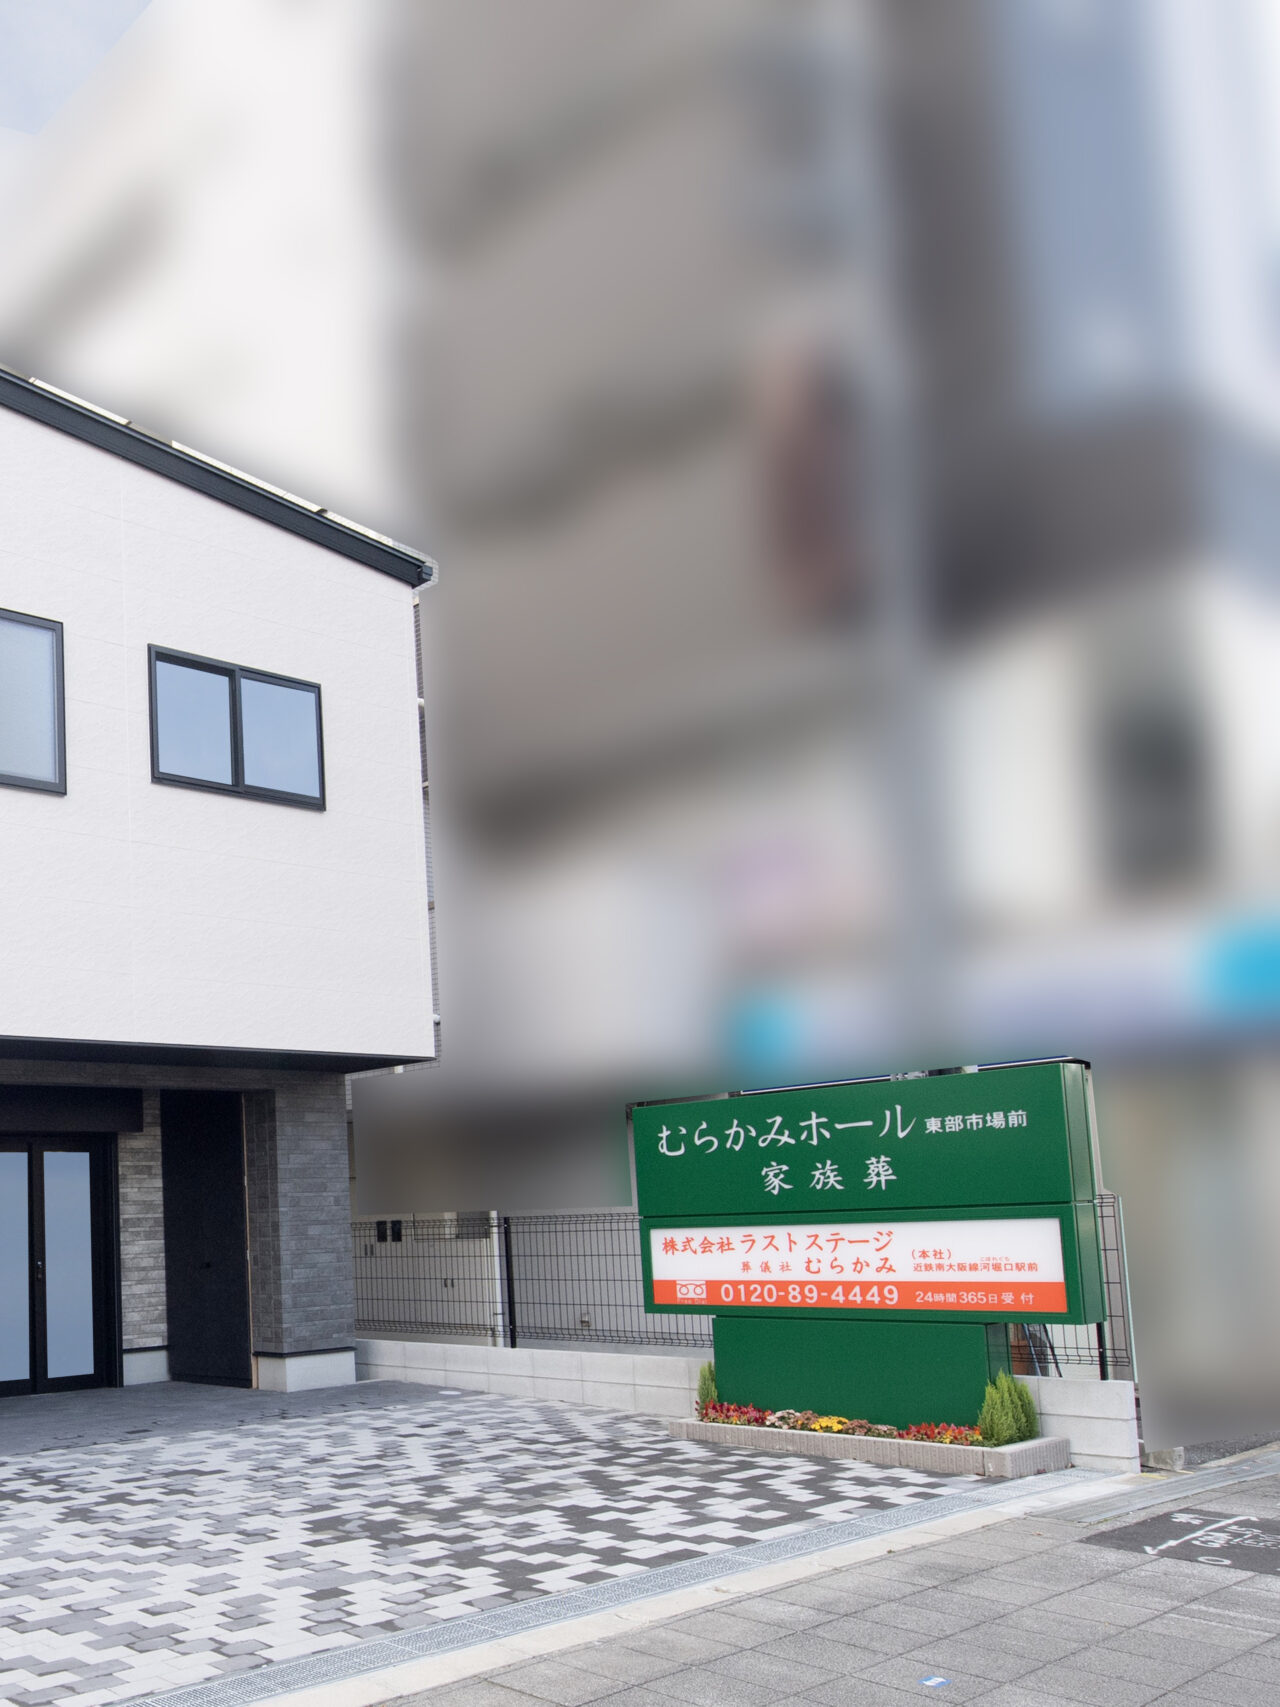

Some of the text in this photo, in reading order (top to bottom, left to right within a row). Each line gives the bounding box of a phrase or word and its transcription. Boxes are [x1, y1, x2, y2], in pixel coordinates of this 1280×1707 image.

[657, 1104, 1028, 1157] むらかみホール 東部市場前
[761, 1154, 898, 1196] 家族葬
[804, 1256, 897, 1275] むらかみ
[721, 1283, 899, 1305] 0120-89-4449
